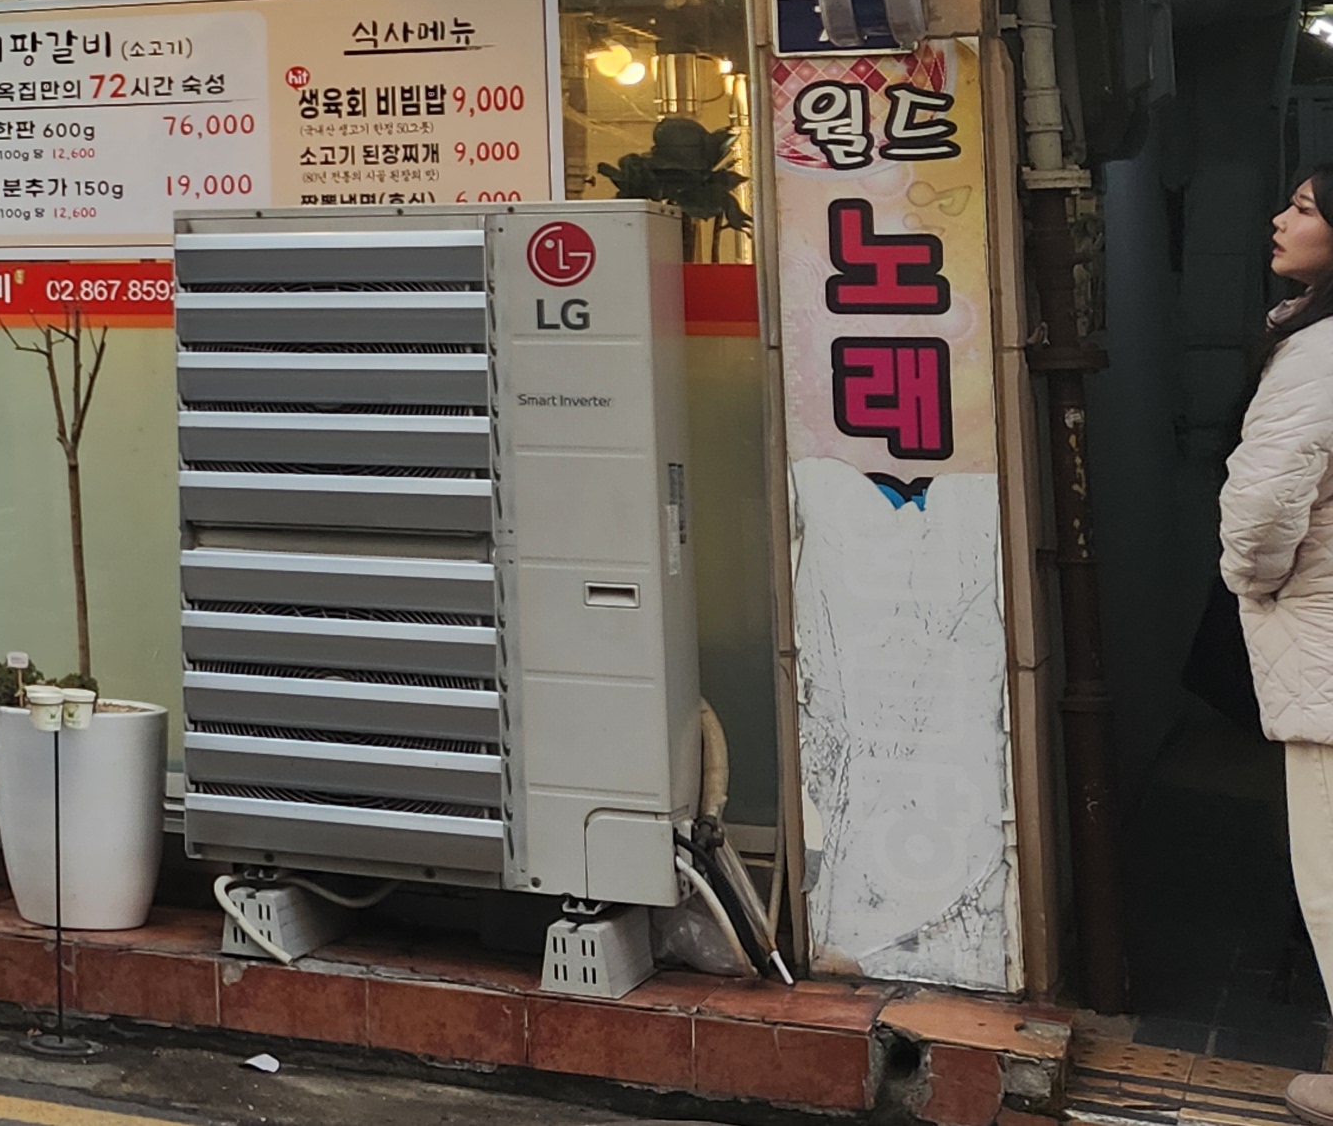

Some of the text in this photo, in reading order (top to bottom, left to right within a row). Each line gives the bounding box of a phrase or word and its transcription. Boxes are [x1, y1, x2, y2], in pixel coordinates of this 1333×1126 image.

[351, 17, 476, 49] 식사메뉴
[120, 38, 193, 62] (소고기)
[181, 73, 226, 95] 숙성
[289, 70, 308, 85] hit
[298, 83, 525, 120] 생육회 비빔밥 9,000
[42, 122, 96, 141] 600g
[162, 114, 256, 139] 76,000
[795, 81, 961, 169] 월드
[51, 147, 96, 161] 12,600
[300, 141, 520, 166] 소고기 된장찌개 9,000
[74, 180, 124, 201] 150g
[165, 173, 253, 199] 19,000
[0, 207, 31, 221] 100g
[52, 206, 97, 220] 12,600
[536, 298, 591, 330] LG
[826, 198, 954, 499] 노래
[516, 393, 612, 407] Smart Inverter
